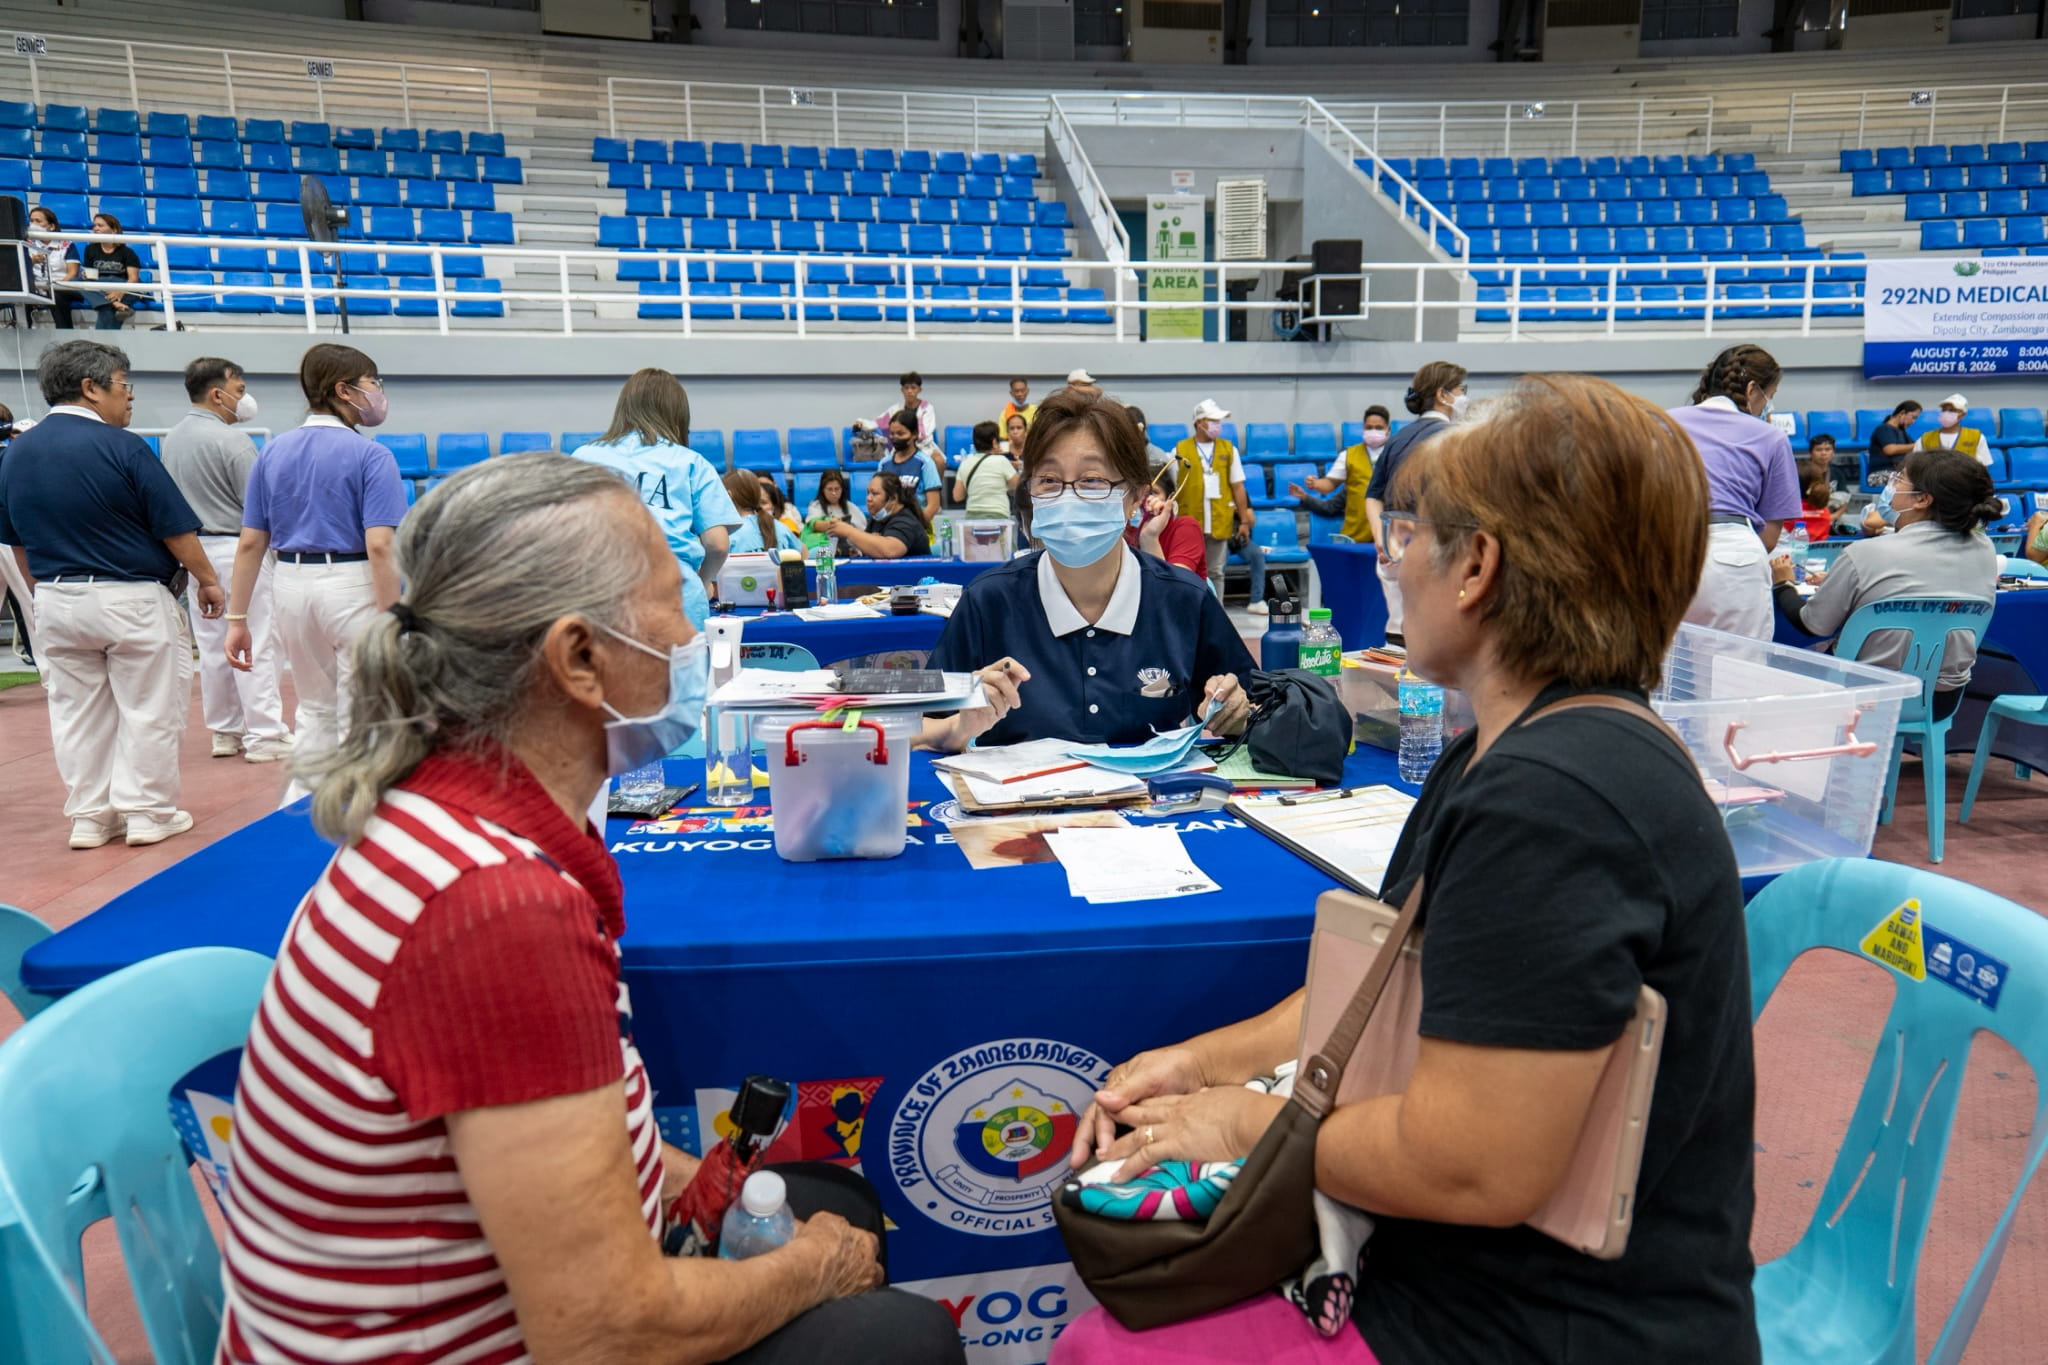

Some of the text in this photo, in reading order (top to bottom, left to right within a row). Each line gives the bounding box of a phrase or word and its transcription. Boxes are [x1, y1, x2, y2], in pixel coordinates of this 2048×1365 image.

[1152, 276, 1199, 289] AREA
[1881, 285, 2048, 305] 292ND MEDICAL
[1932, 311, 1978, 323] Extending
[1980, 311, 2035, 322] Compassion
[1932, 325, 1967, 336] Dipolog
[1992, 324, 2045, 335] Zamboanga
[1910, 346, 2048, 359] AUGUST 6-7, 2026 8:00A
[1908, 360, 2048, 373] AUGUST 8, 2026 8:00A
[610, 838, 774, 855] KUYOG
[1887, 919, 1918, 945] BAWAL
[1889, 935, 1909, 955] AND
[891, 1041, 1100, 1189] PROVINCE OF ZAMBOANGA
[953, 1178, 1041, 1202] UNITY PROSPERITY
[950, 1210, 1036, 1231] OFFICIAL
[937, 1284, 1068, 1329] YOG
